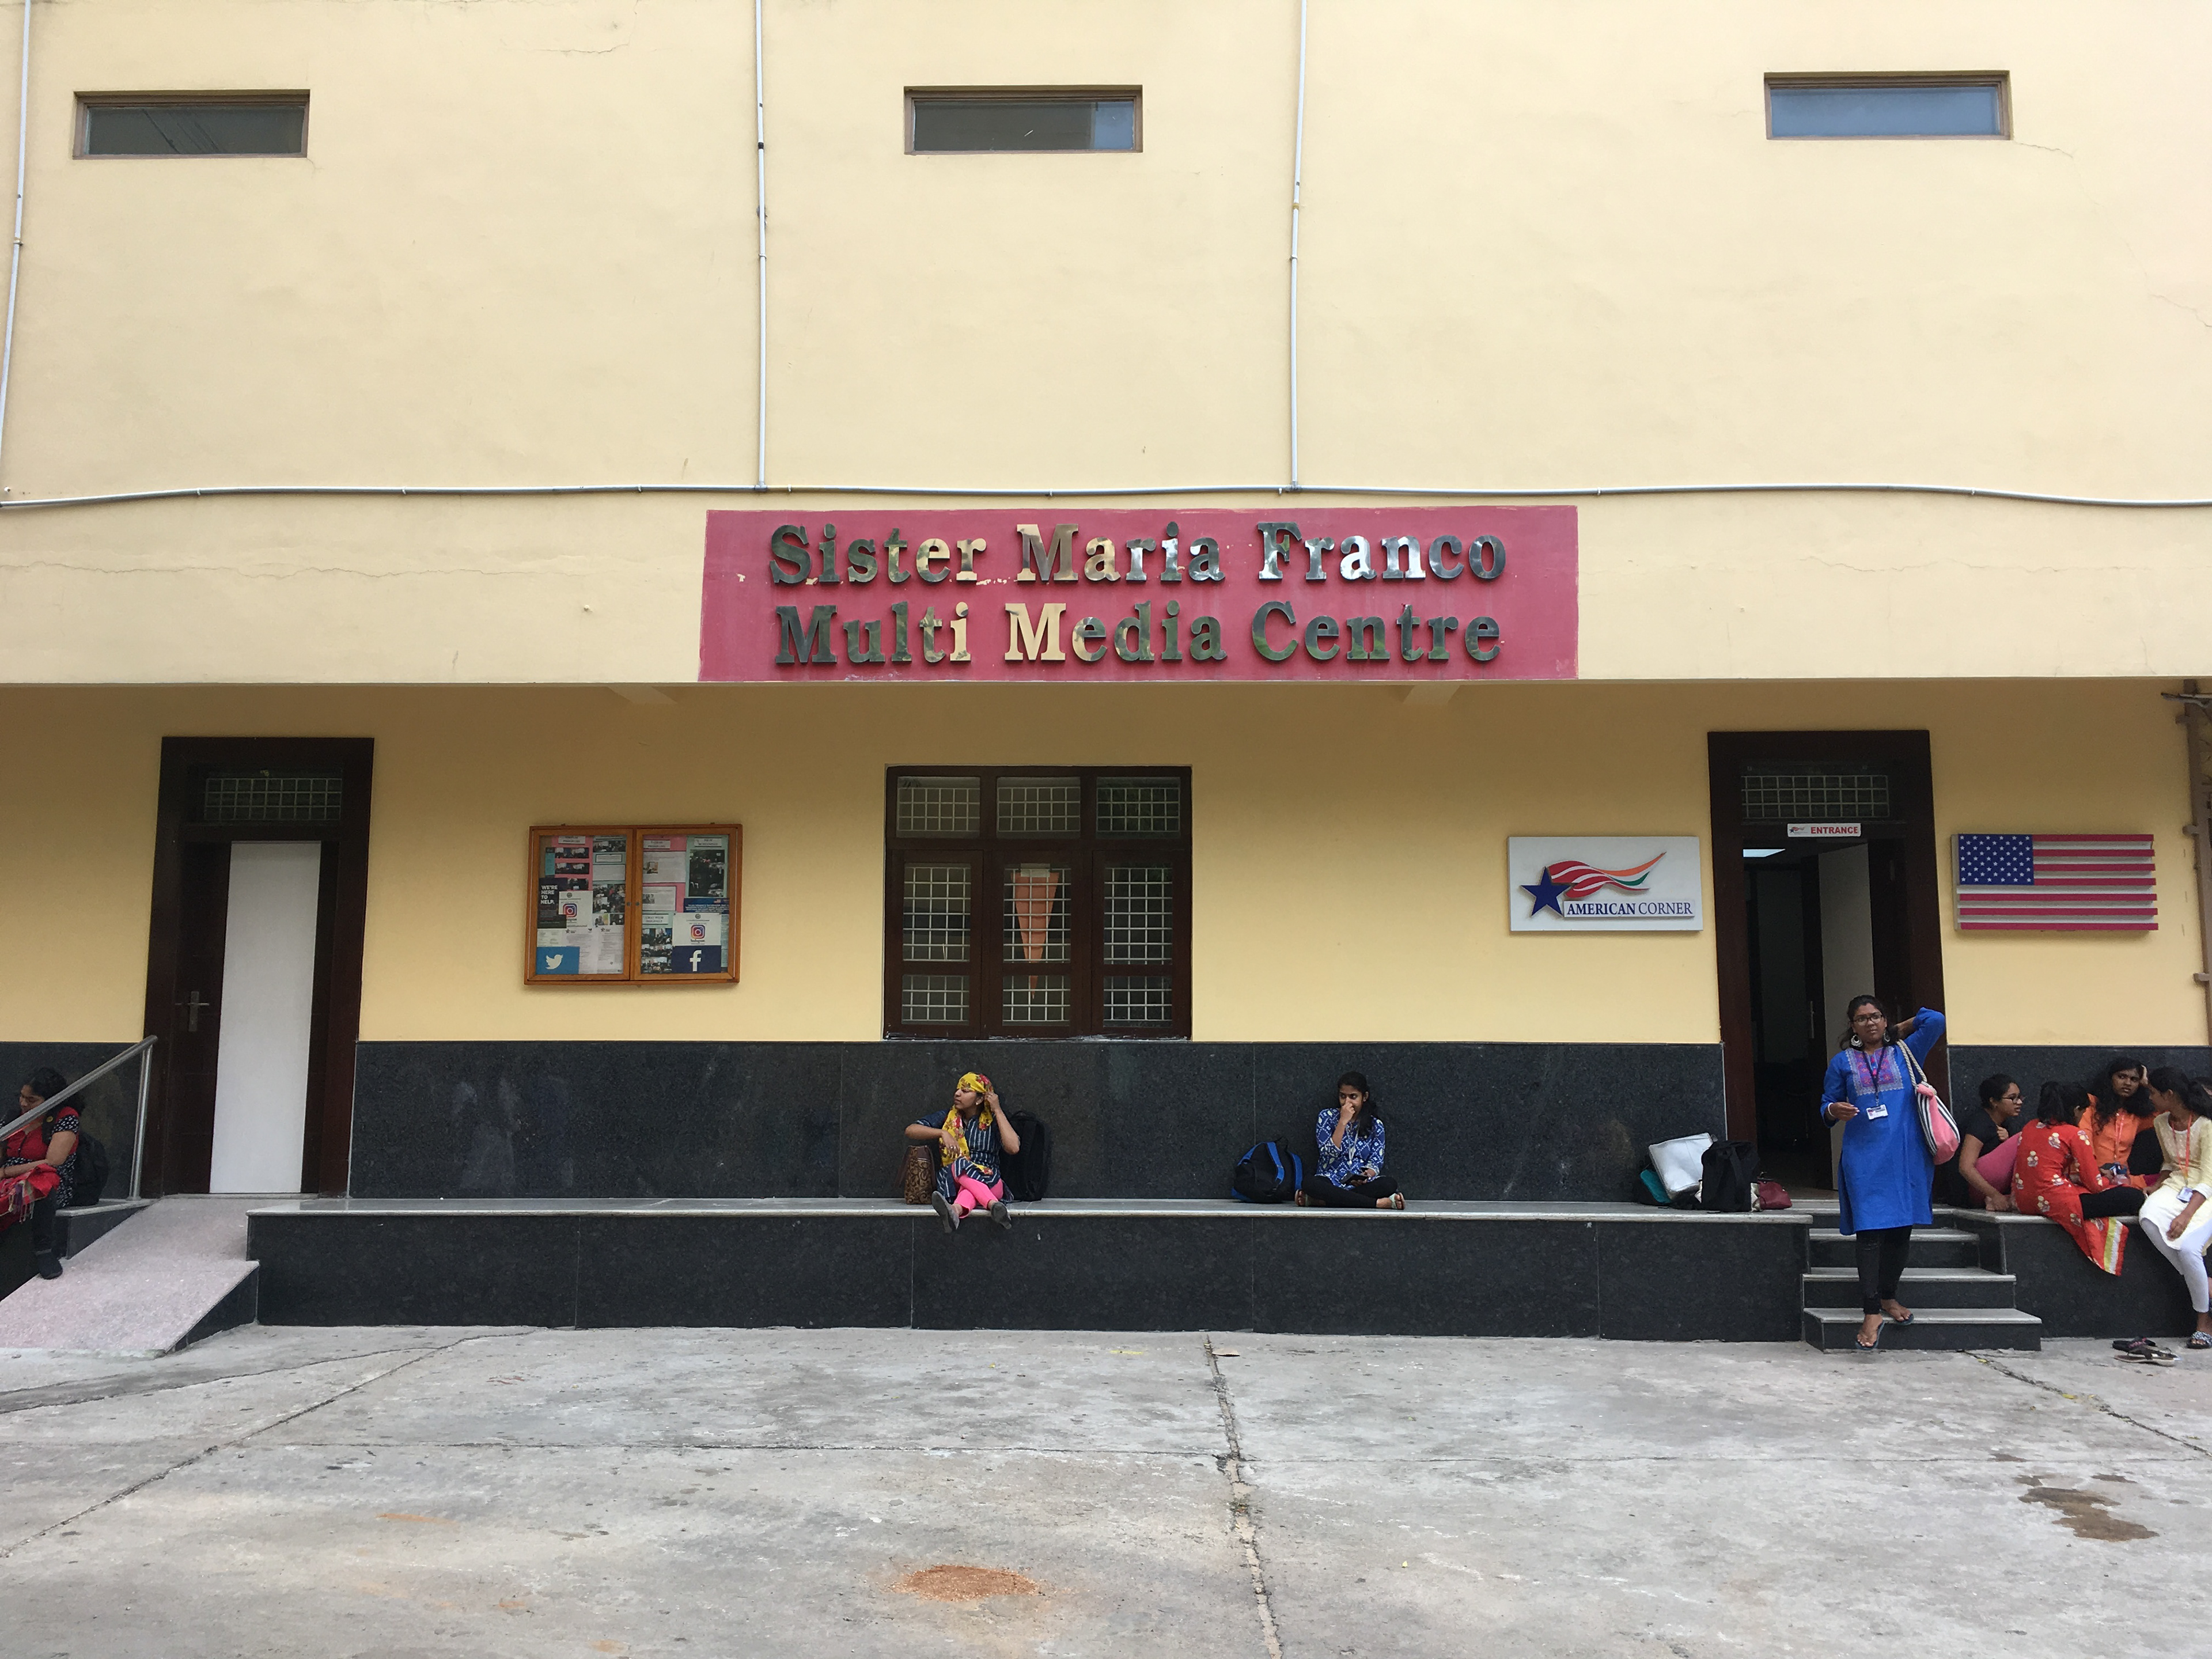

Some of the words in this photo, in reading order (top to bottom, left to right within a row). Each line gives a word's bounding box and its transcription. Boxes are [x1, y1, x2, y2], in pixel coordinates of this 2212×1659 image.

[770, 522, 987, 584] Sister
[1016, 521, 1226, 582] Maria
[1257, 521, 1506, 580] Franco
[775, 601, 972, 663] Multi
[1004, 600, 1228, 662] Media
[1251, 600, 1501, 661] Centre
[1810, 826, 1858, 834] ENTRANCE
[1566, 903, 1636, 915] AMERICAN
[1638, 902, 1693, 915] CORNER
